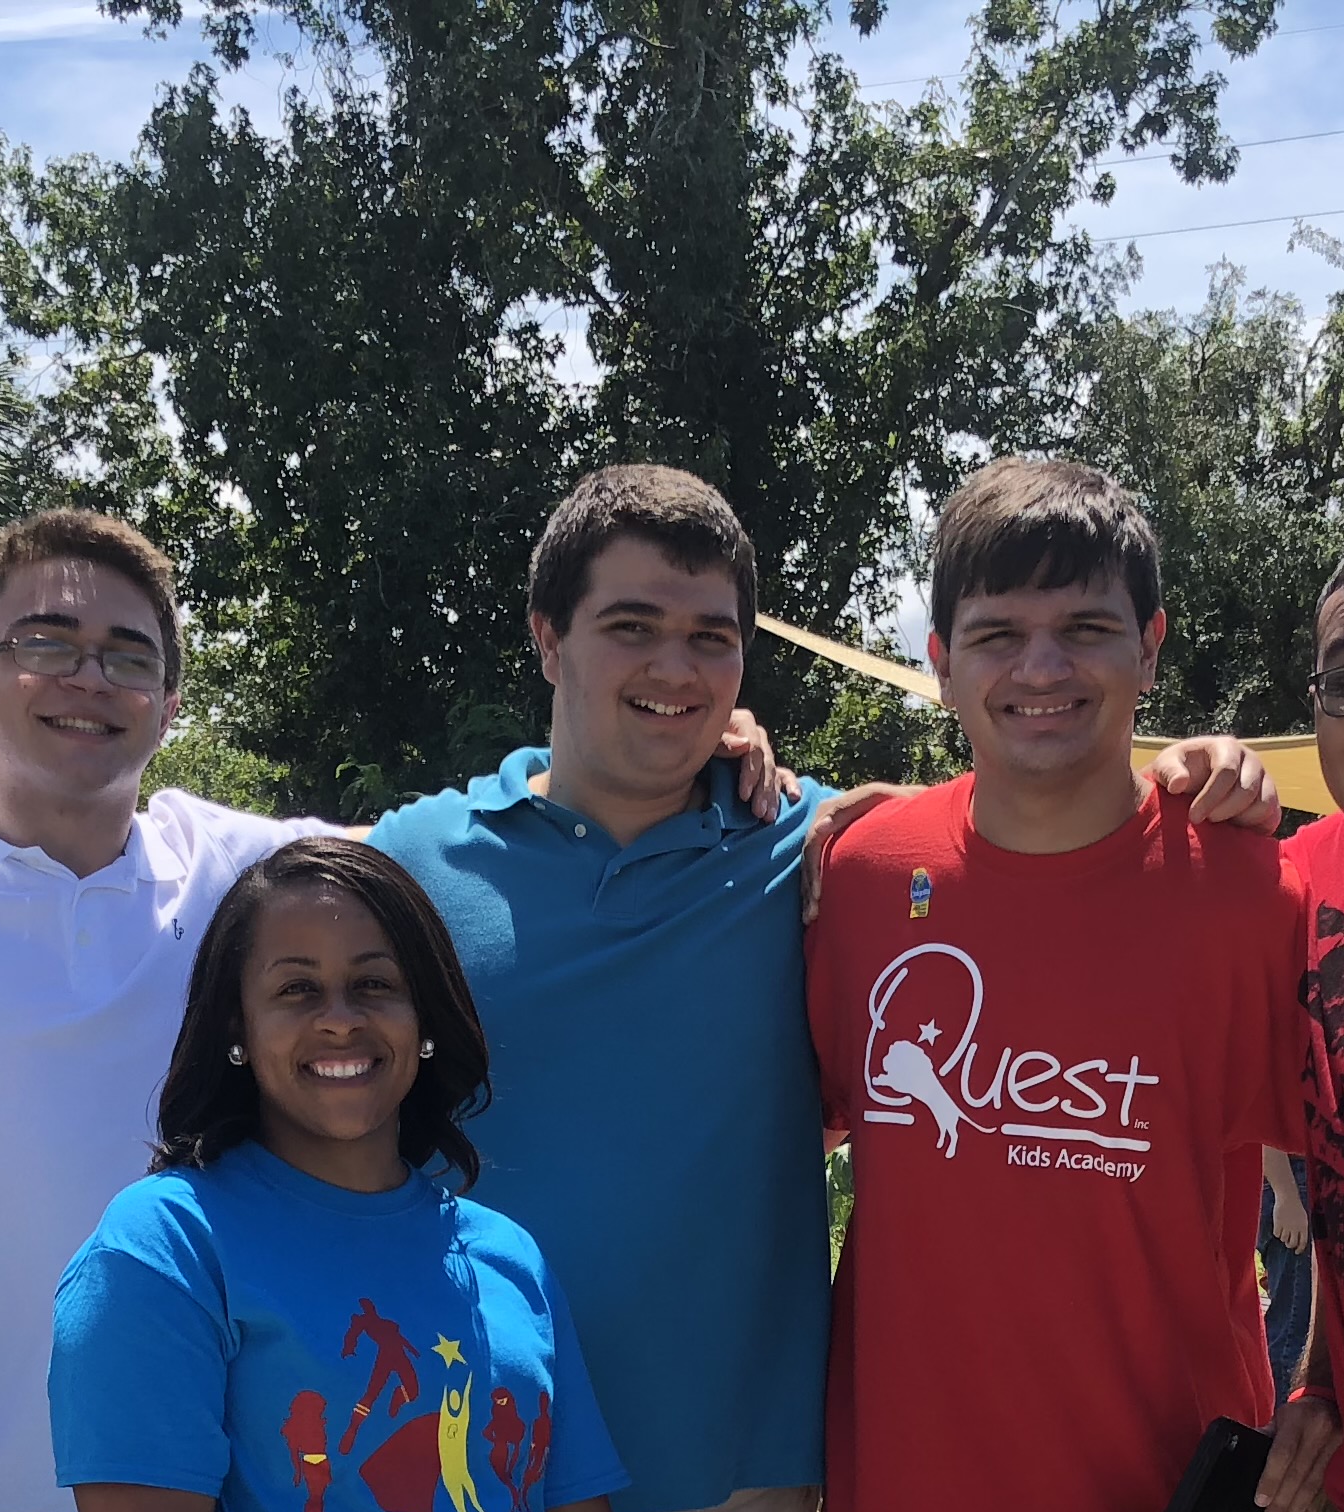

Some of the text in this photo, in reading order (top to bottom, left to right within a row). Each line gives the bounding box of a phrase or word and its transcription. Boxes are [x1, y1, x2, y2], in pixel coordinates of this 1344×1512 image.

[1133, 1118, 1150, 1130] Inc
[1007, 1144, 1146, 1183] Kids Academy
